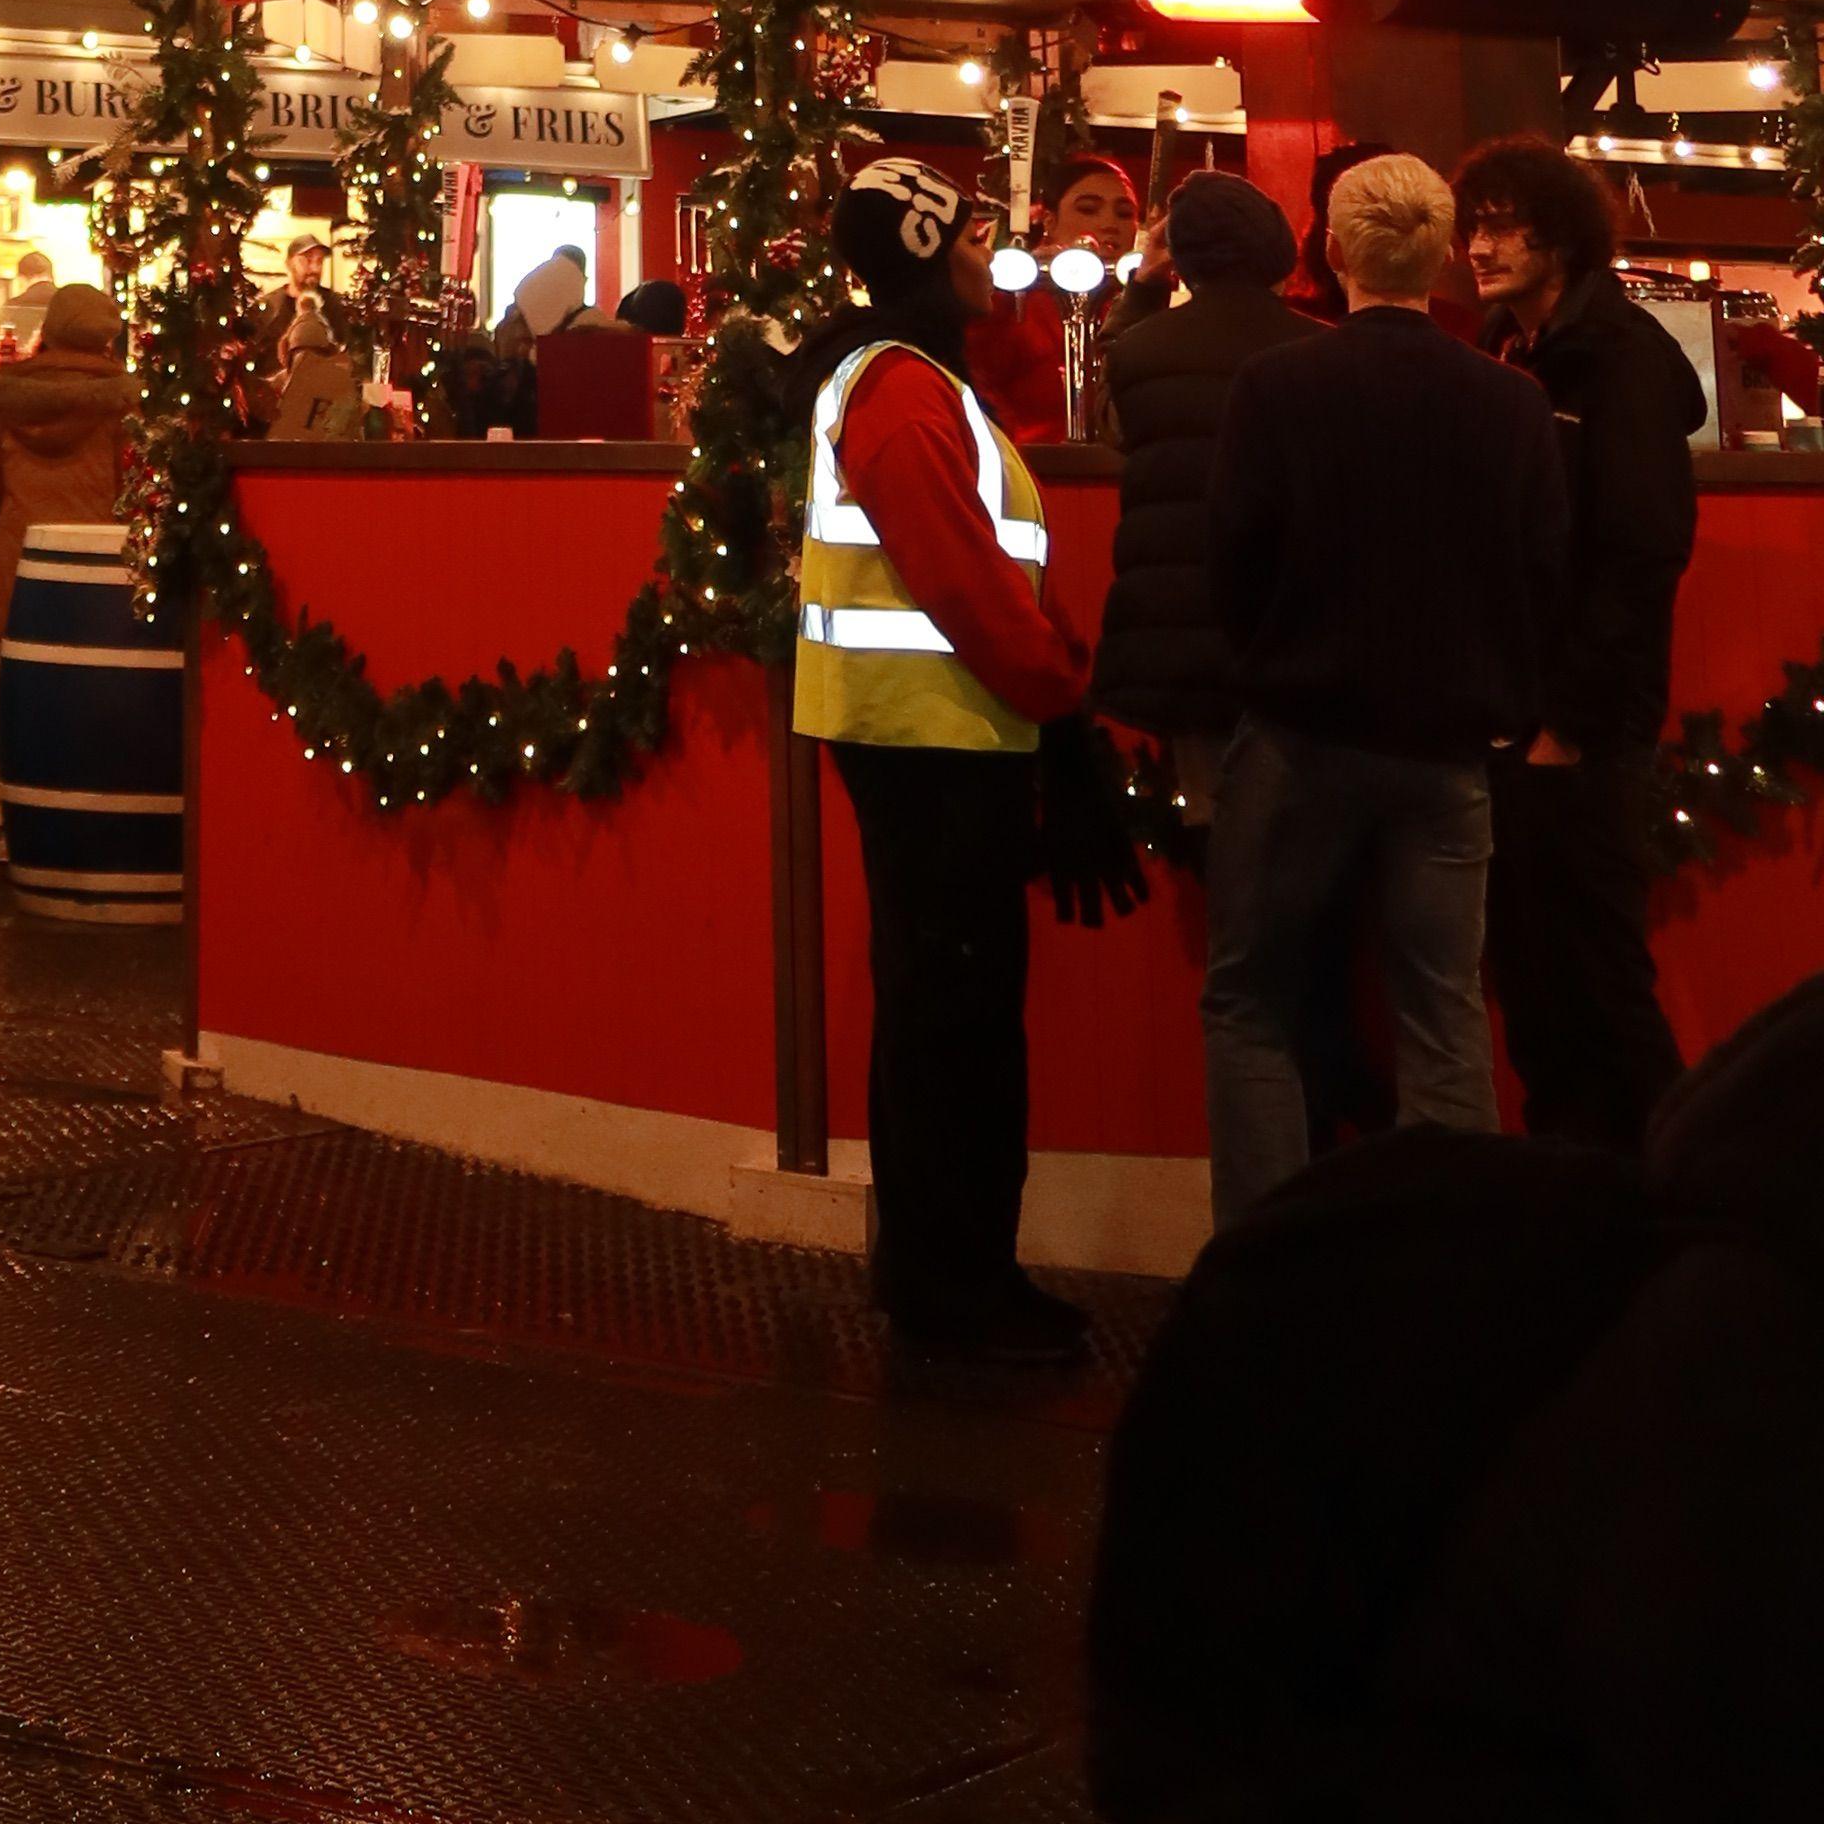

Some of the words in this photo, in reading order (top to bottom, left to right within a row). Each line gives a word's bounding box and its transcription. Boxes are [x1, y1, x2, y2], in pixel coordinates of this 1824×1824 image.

[464, 103, 497, 139] &
[511, 106, 625, 148] FRIES
[1010, 107, 1030, 162] PRAVHA
